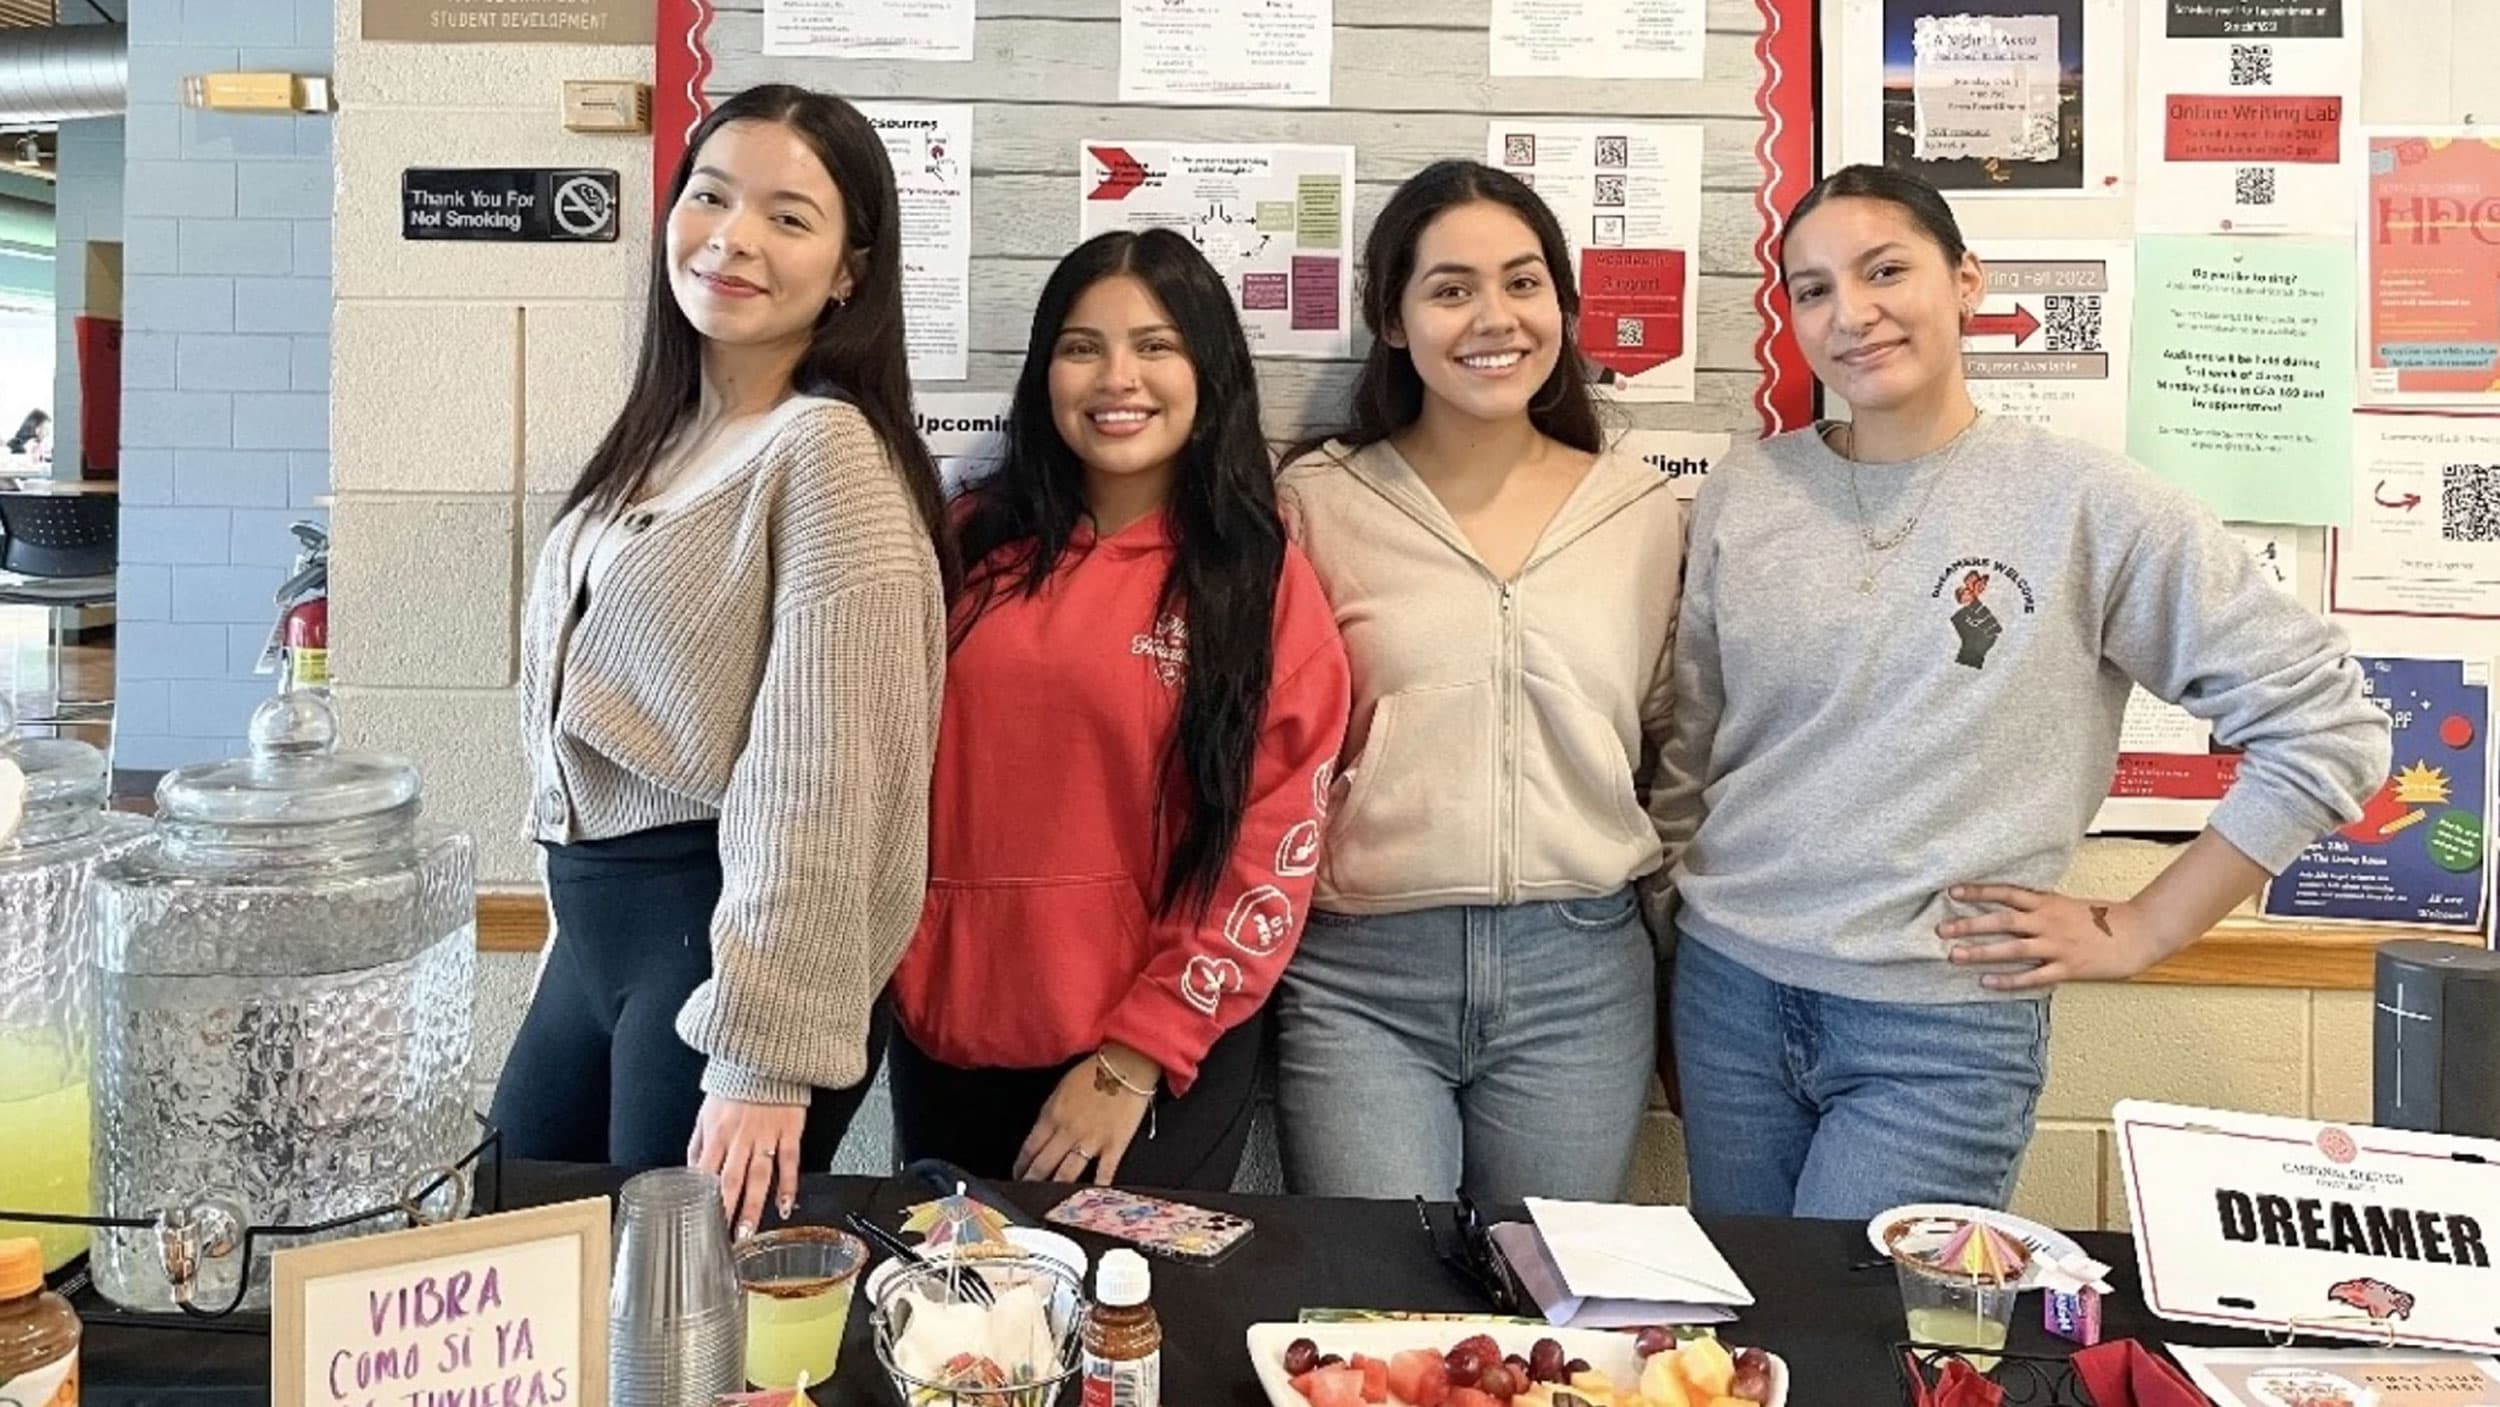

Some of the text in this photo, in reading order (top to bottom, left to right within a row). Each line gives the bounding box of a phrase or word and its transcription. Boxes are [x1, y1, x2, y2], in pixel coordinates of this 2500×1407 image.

[430, 10, 608, 30] STUDENT DEVELOPMENT
[864, 117, 938, 130] esources
[2169, 104, 2339, 123] Online Writing Lab
[411, 190, 535, 208] Thank You For
[411, 210, 522, 232] Not Smoking
[1987, 271, 2019, 287] ring
[2055, 271, 2096, 287] 2022
[915, 414, 1009, 435] Upcomi
[1642, 455, 1709, 479] light
[1993, 560, 2035, 615] WELCOME
[2215, 1187, 2491, 1268] DREAMER
[369, 1266, 502, 1337] VIBRA
[328, 1343, 420, 1401] COMO
[495, 1317, 534, 1370] YA
